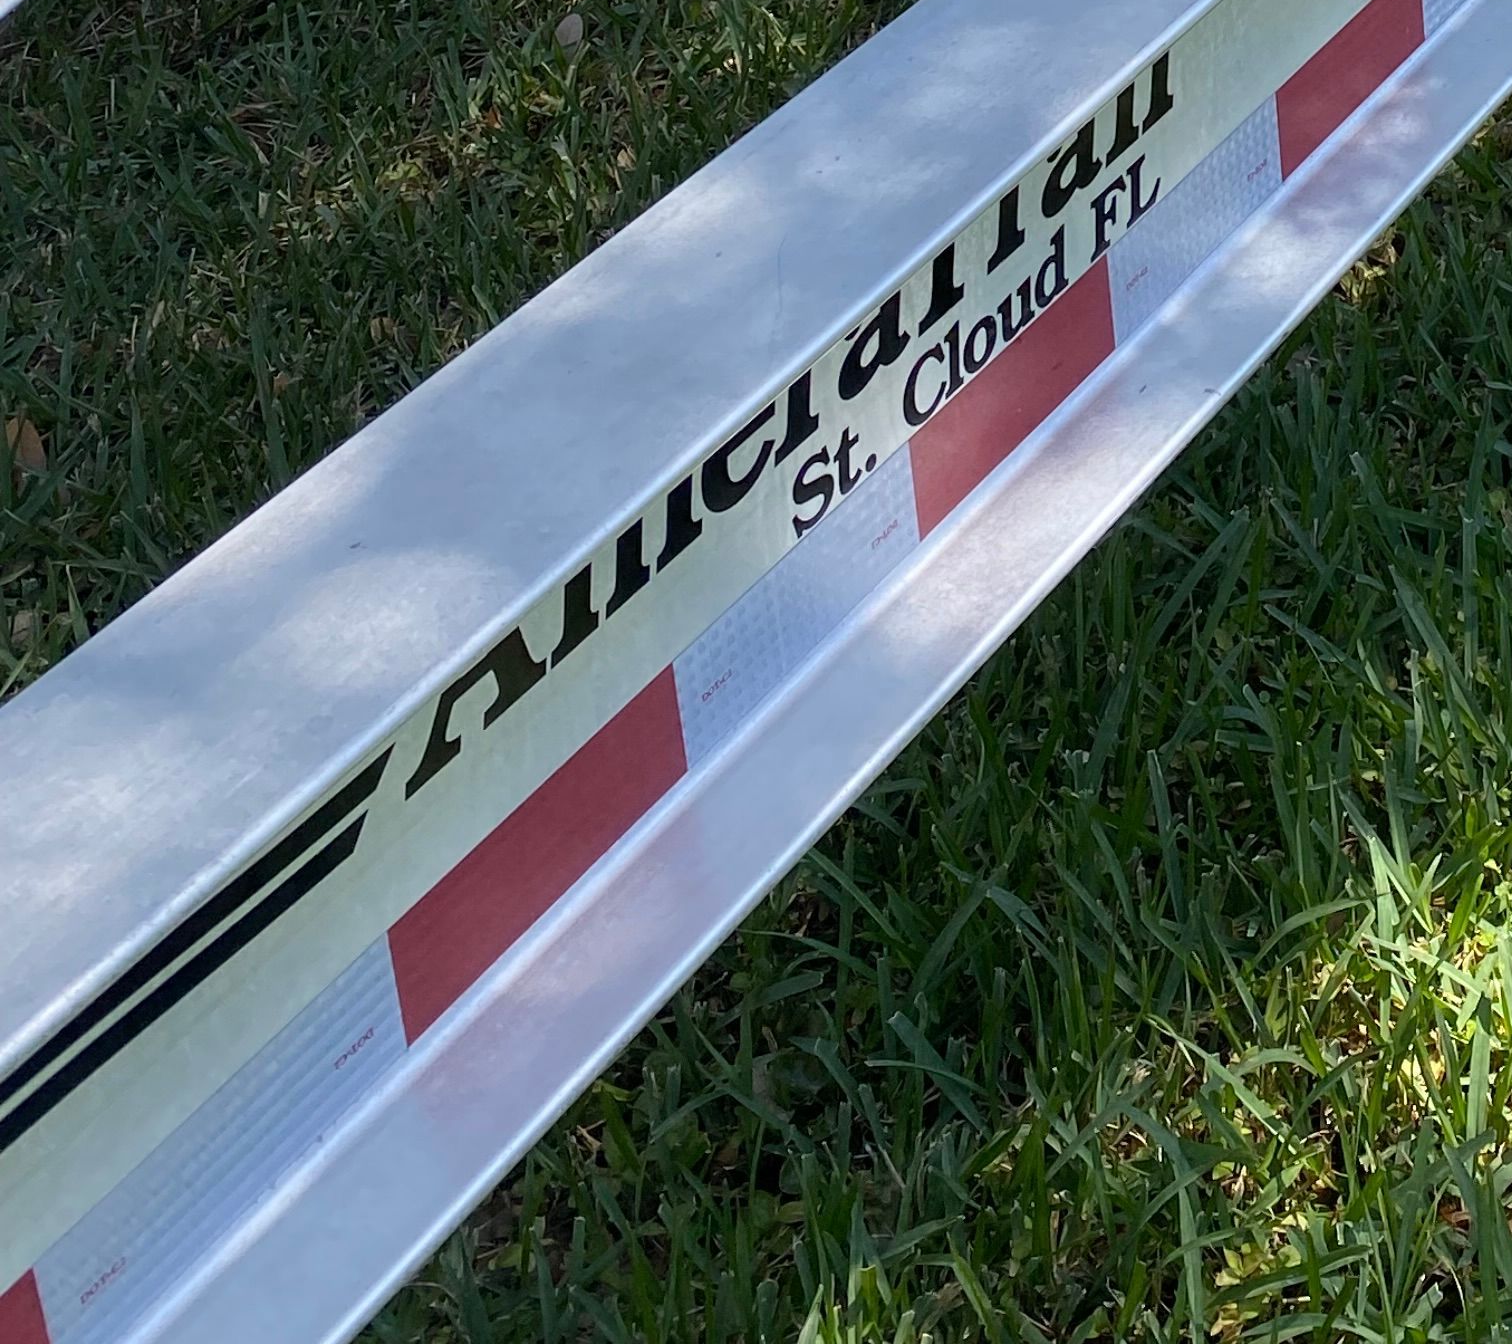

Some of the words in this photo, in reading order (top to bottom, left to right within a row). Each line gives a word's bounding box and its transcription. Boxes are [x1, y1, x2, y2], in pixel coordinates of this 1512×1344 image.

[790, 436, 878, 539] St.
[903, 223, 1069, 427] Cloud
[1090, 154, 1161, 262] FL
